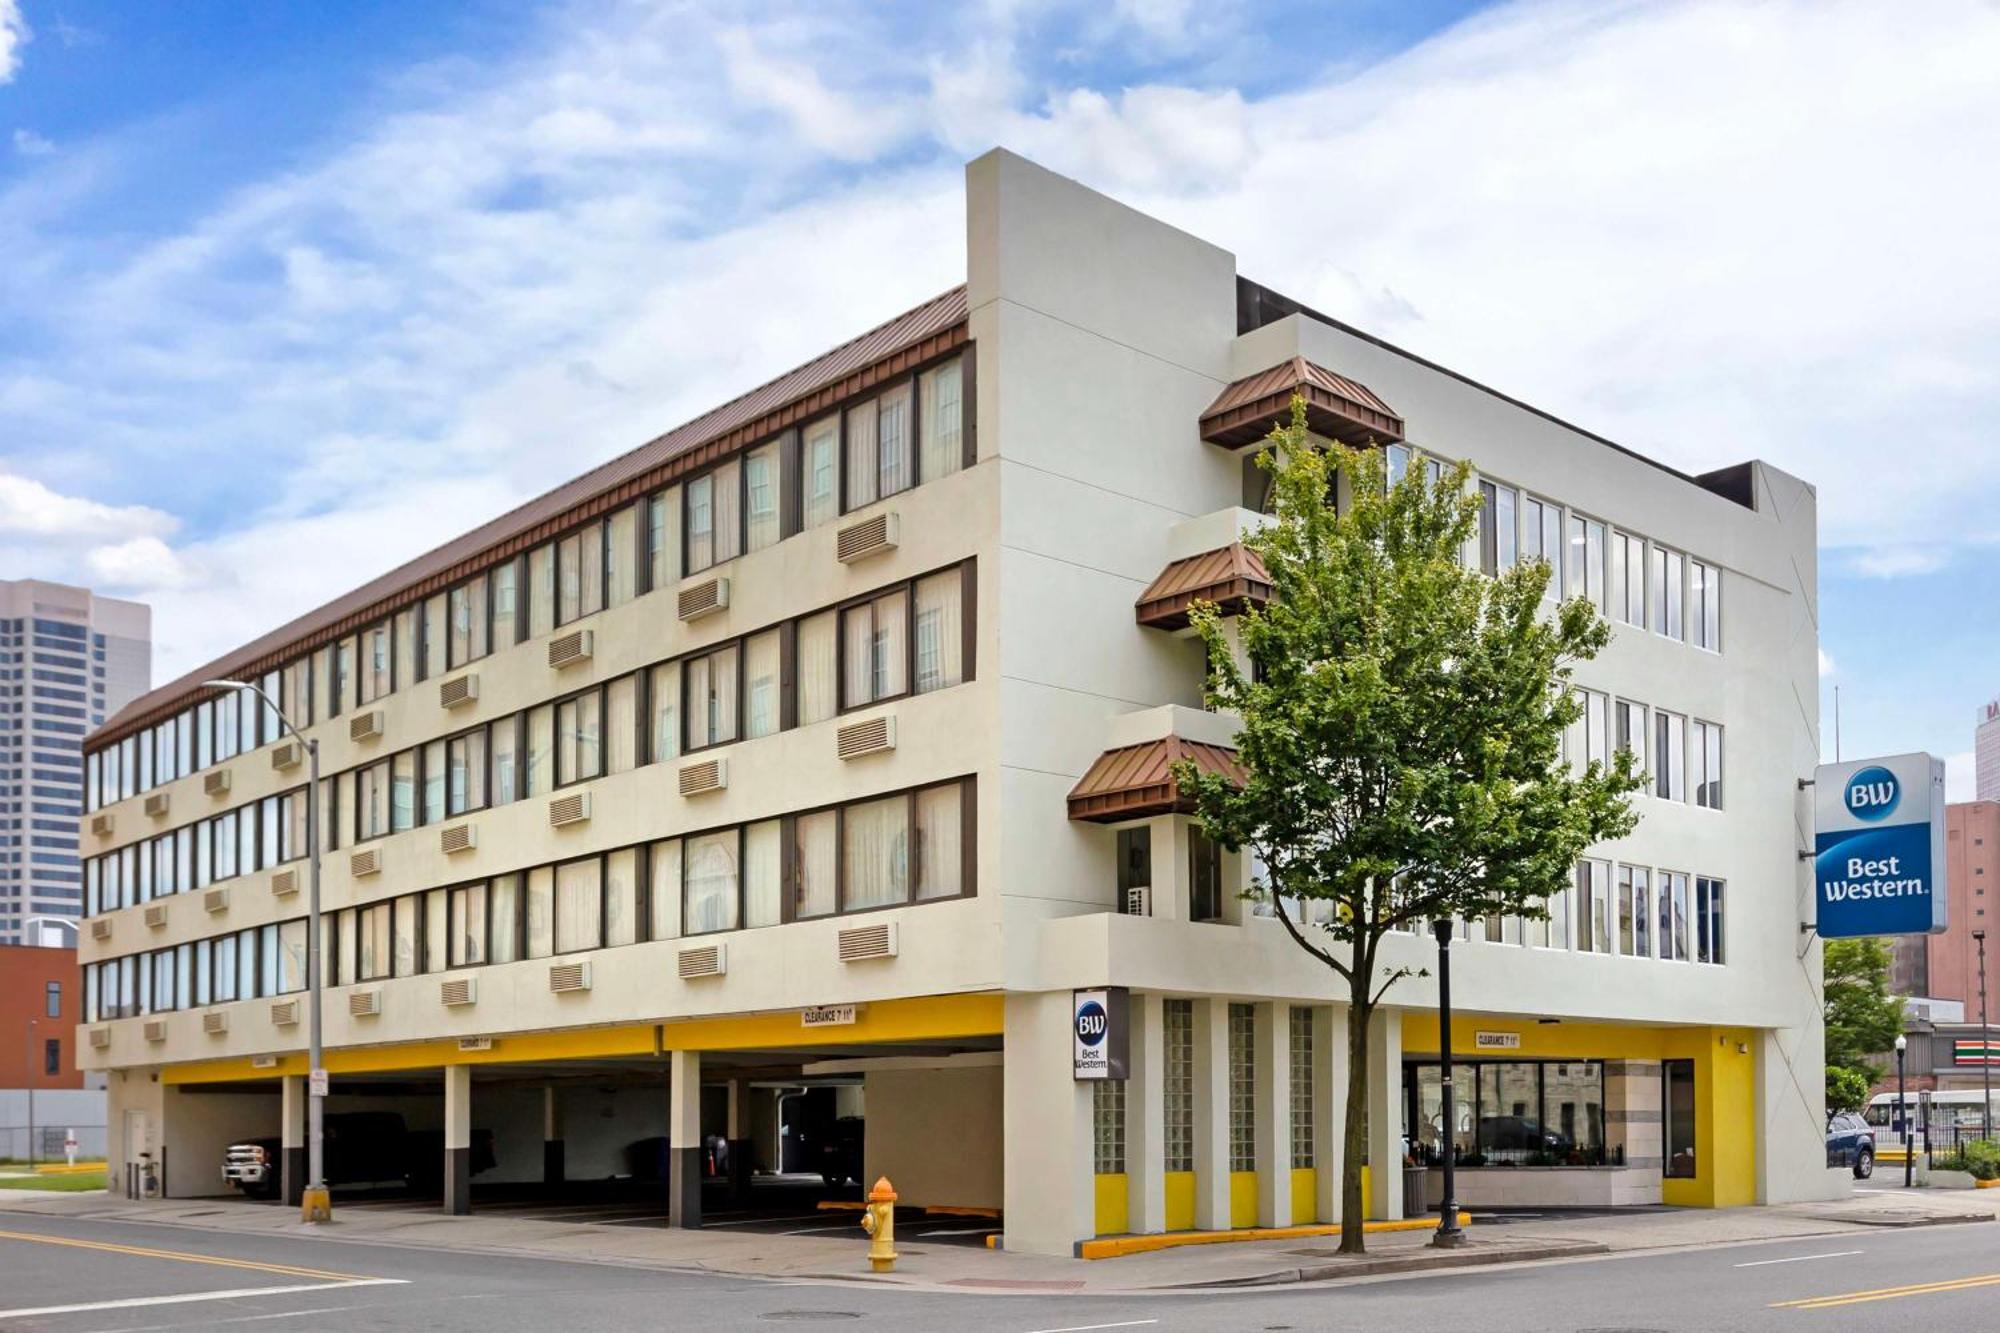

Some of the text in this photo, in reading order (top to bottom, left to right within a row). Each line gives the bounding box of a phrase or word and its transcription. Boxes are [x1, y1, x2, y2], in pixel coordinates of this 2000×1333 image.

[1851, 781, 1894, 808] BW
[1847, 856, 1900, 879] Best
[1824, 877, 1924, 902] Western
[805, 1010, 835, 1023] CLEARANCE
[1079, 1015, 1105, 1035] BW
[1075, 1059, 1107, 1069] Western
[1082, 1049, 1100, 1059] Best
